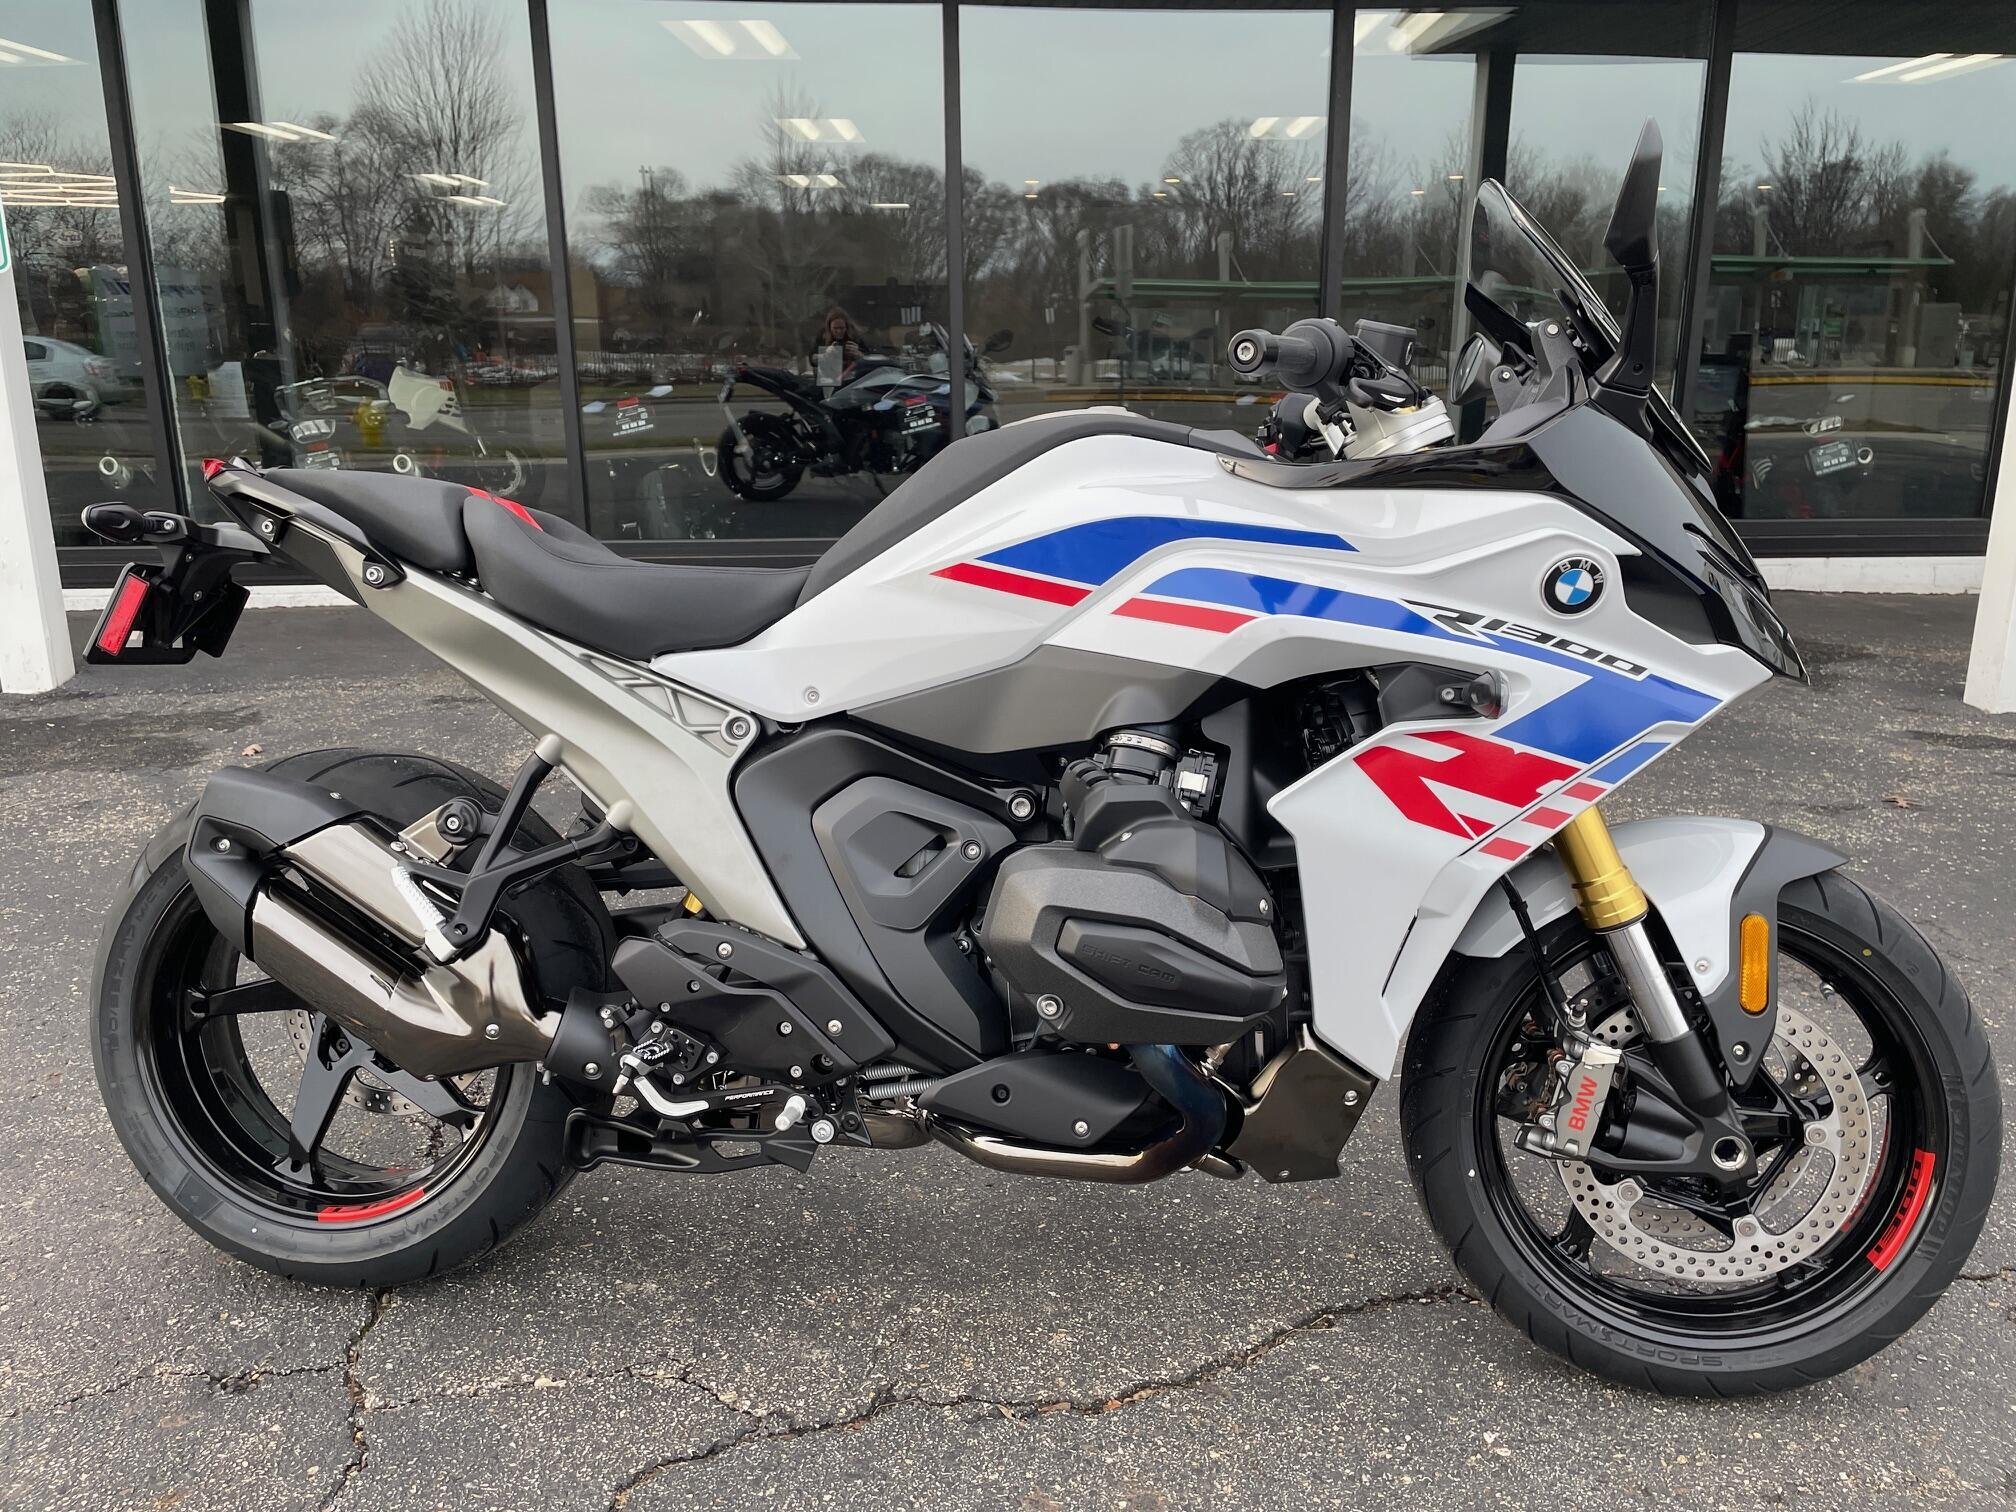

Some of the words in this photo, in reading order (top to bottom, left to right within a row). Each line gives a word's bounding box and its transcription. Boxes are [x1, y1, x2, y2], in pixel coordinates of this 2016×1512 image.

[1558, 558, 1604, 585] BMW
[1400, 598, 1648, 677] R1300
[1137, 963, 1176, 984] CAM
[724, 1089, 775, 1101] PERFORMANCE
[1568, 1074, 1598, 1132] BMW
[1526, 1280, 1723, 1367] SPORTSMART
